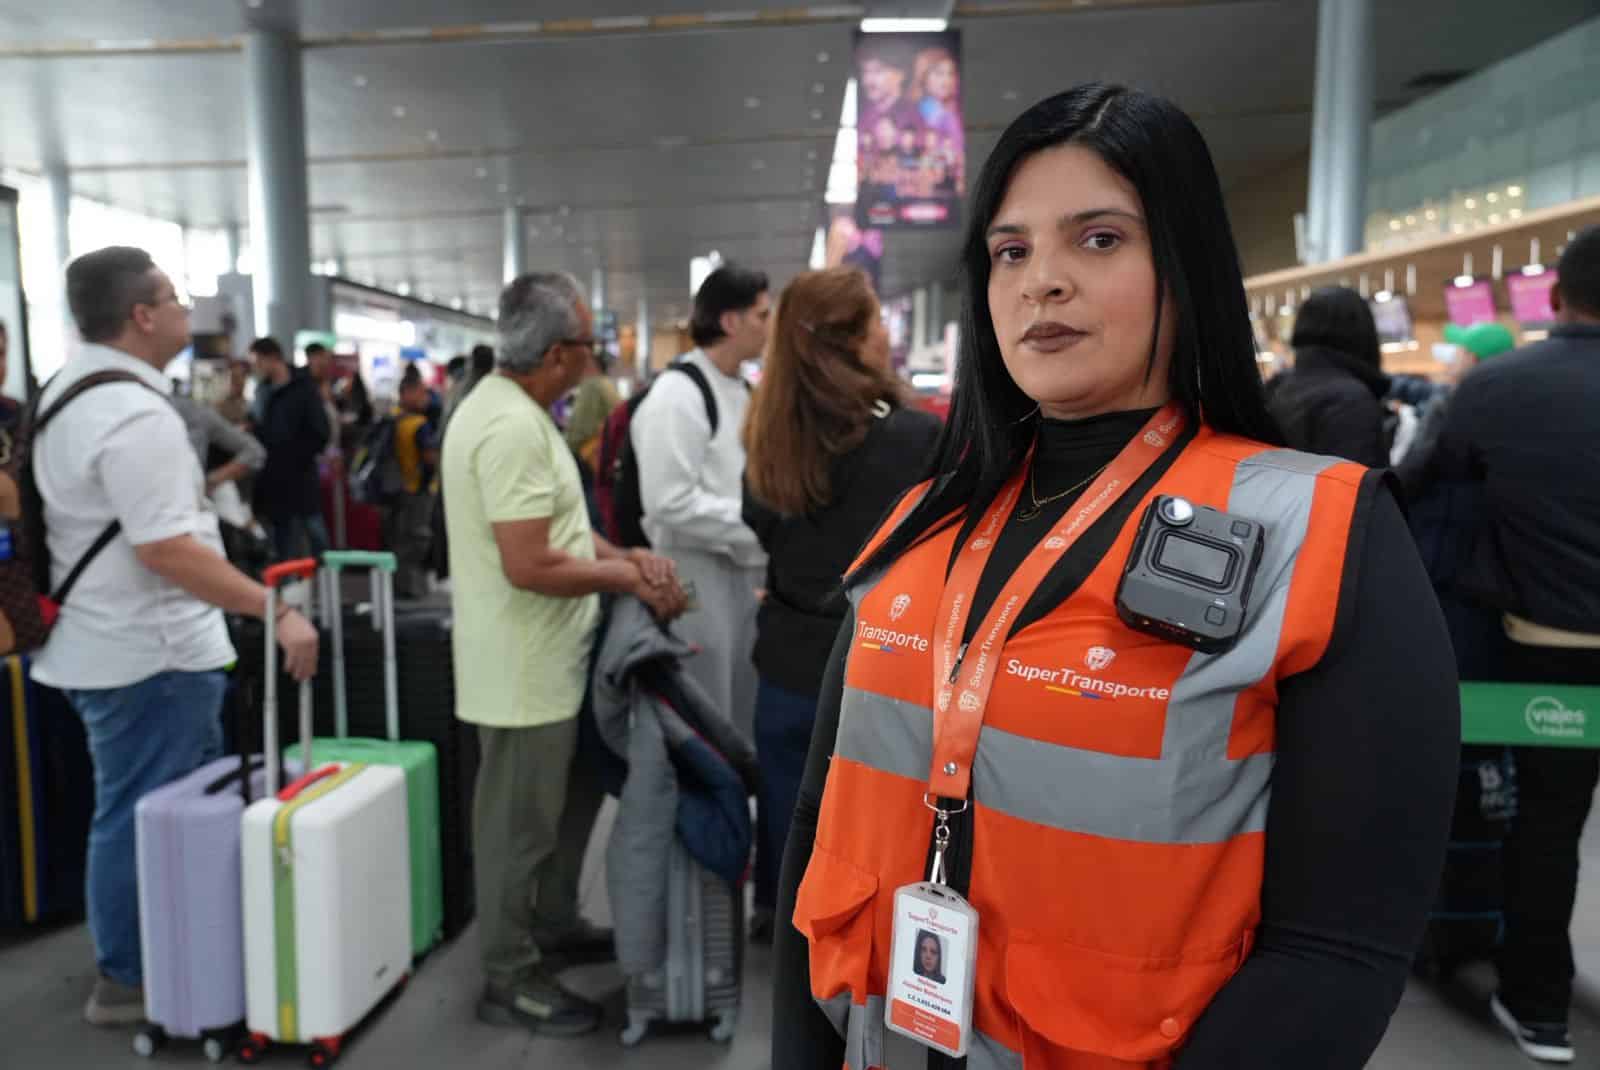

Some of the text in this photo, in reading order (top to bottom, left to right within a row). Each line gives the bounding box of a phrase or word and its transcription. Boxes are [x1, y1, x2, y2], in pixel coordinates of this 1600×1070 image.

[858, 619, 929, 652] Transporte
[969, 594, 1019, 689] SuperTransporte
[1006, 659, 1170, 700] SuperTransporte
